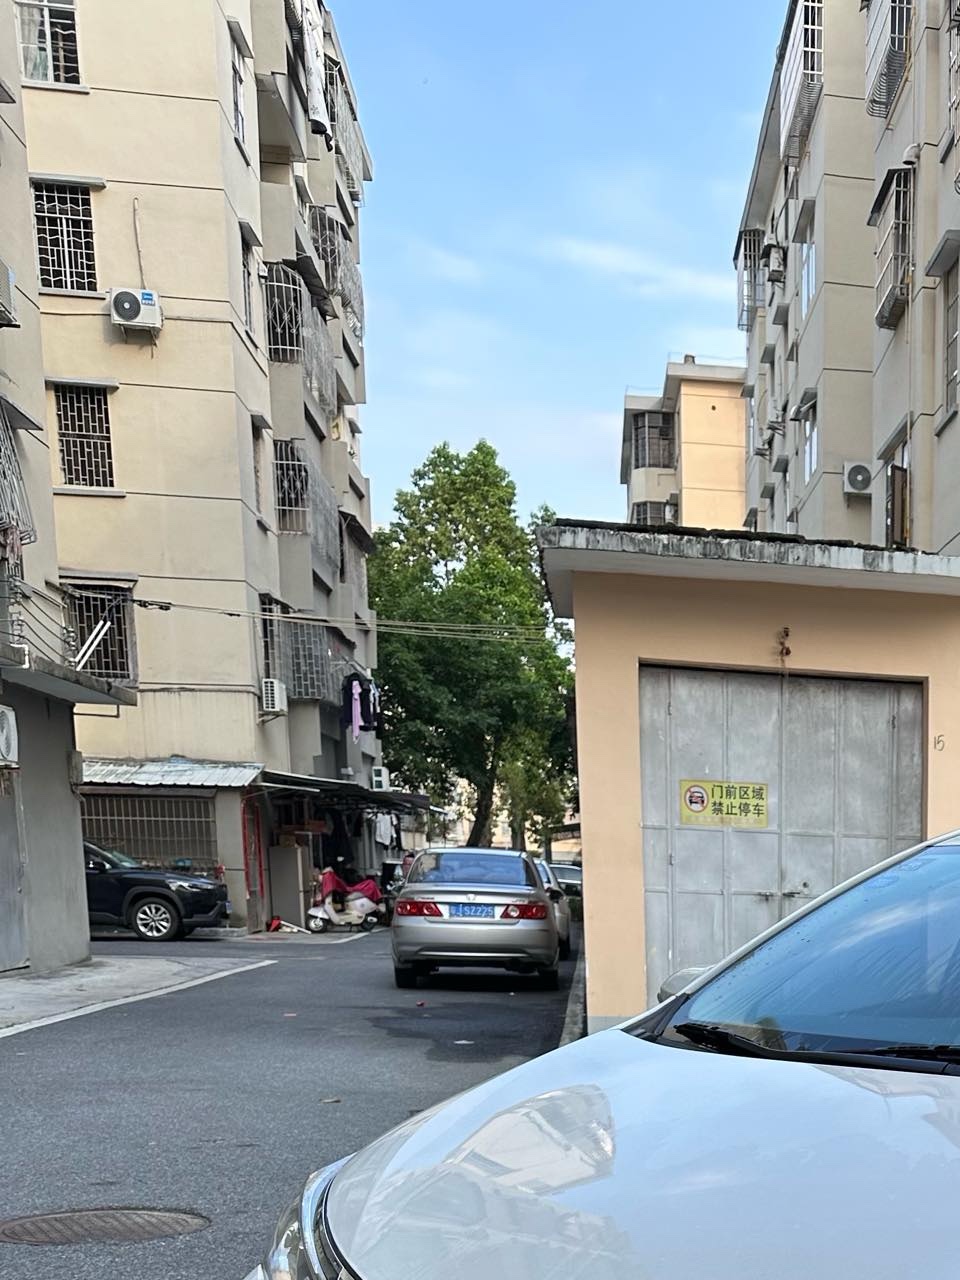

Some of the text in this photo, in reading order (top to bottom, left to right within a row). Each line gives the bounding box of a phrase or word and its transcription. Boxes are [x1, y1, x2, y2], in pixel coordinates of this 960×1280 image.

[933, 734, 945, 752] 15
[711, 784, 765, 801] 门前区域
[711, 800, 765, 817] 禁止停车
